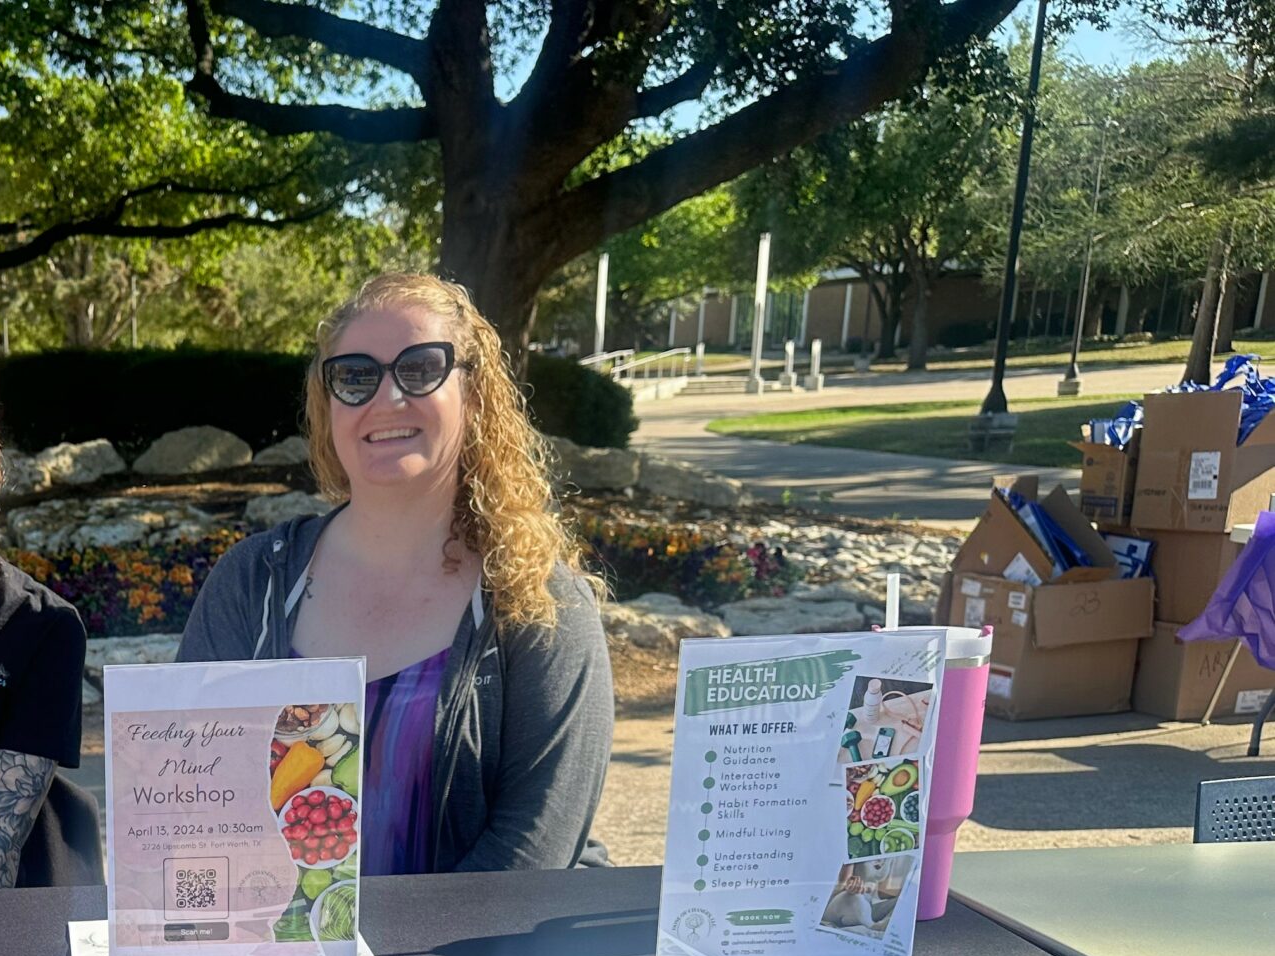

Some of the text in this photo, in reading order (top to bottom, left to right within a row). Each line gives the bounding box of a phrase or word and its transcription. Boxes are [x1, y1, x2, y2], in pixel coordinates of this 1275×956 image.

[707, 666, 778, 685] HEALTH
[706, 683, 817, 703] EDUCATION
[127, 720, 247, 748] Feeding Your
[709, 721, 798, 736] WHAT WE OFFER:
[723, 745, 772, 754] Nutrition
[722, 755, 776, 765] Guidance
[157, 755, 223, 777] Mind
[720, 772, 781, 780] Interactive
[720, 781, 778, 792] Workshops
[133, 783, 235, 808] Workshop
[718, 798, 808, 808] Habit Formation
[717, 810, 745, 819] Skills
[127, 826, 153, 839] April
[173, 824, 204, 836] 2024
[217, 823, 264, 834] 10:30am
[715, 827, 792, 838] Mindful Living
[142, 843, 161, 851] 2726
[210, 839, 225, 848] Fort
[252, 839, 262, 847] TX
[714, 850, 794, 861] Understanding
[713, 863, 759, 872] Exercise
[711, 878, 790, 888] Sleep Hygiene
